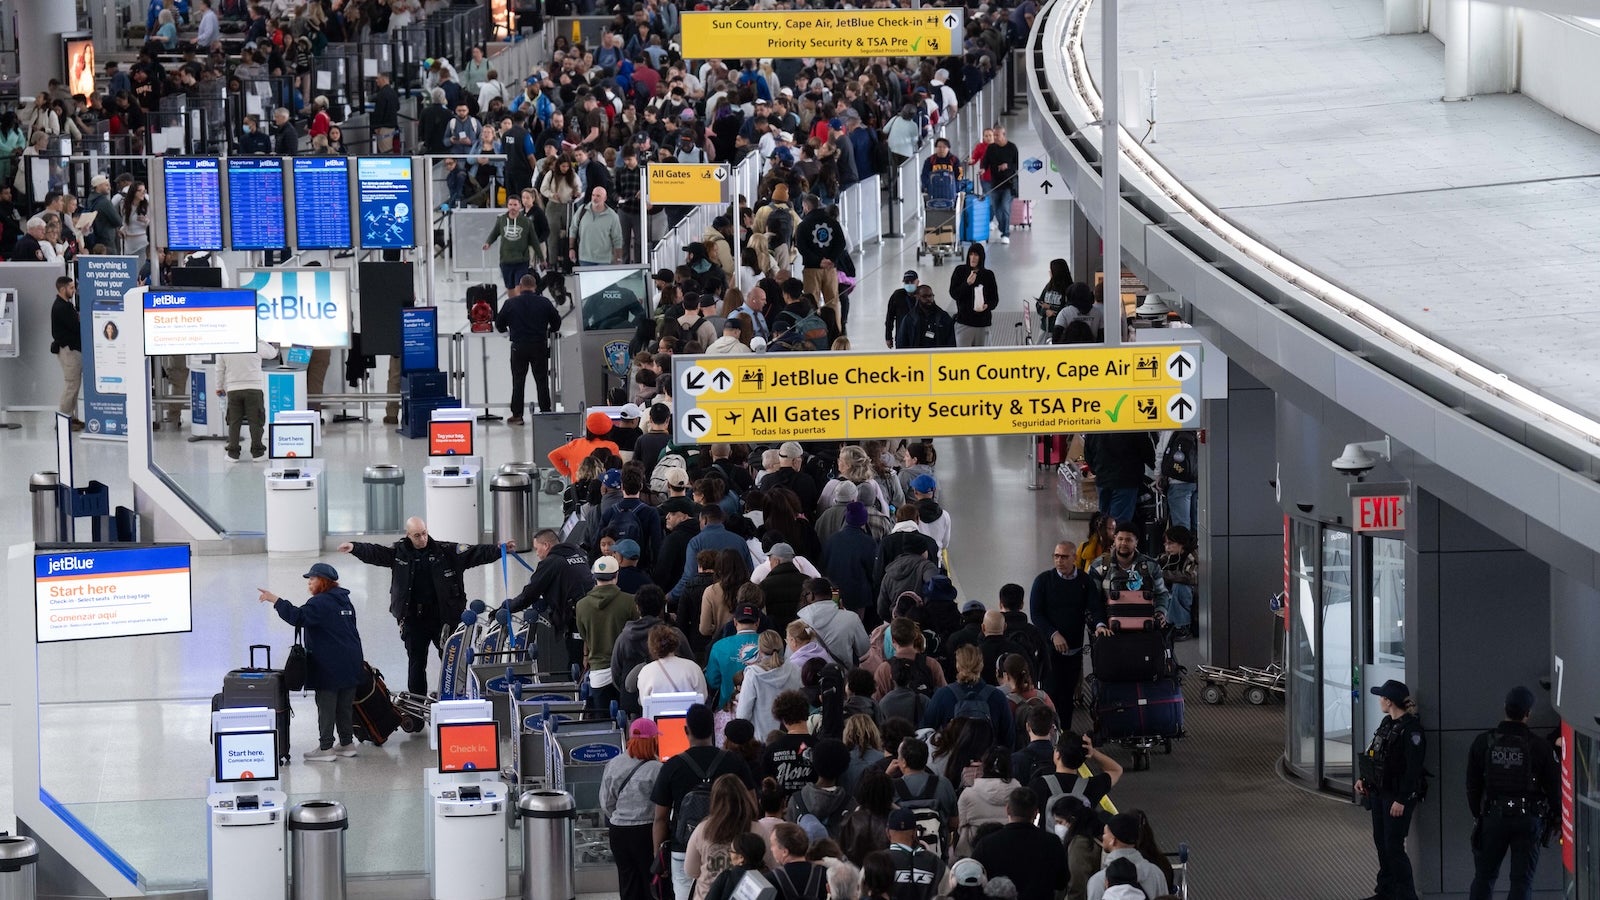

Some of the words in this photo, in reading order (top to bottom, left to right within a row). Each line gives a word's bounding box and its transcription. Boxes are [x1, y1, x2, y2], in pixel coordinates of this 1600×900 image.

[712, 20, 732, 29] Sun
[736, 20, 781, 30] Country,
[786, 19, 812, 30] Cape
[815, 19, 832, 28] Air,
[836, 18, 874, 27] JetBlue
[878, 17, 922, 26] Check-in
[768, 39, 806, 49] Priority
[810, 38, 852, 49] Security
[856, 38, 864, 46] &
[867, 38, 888, 46] TSA
[891, 38, 908, 46] Pre
[196, 160, 215, 168] jetBlue
[652, 170, 664, 178] All
[666, 170, 691, 178] Gates
[89, 262, 122, 270] Everything
[110, 271, 130, 279] phone.
[153, 295, 186, 307] jetBlue
[257, 296, 337, 320] etBlue
[154, 315, 178, 324] Start
[181, 315, 202, 323] here
[607, 344, 629, 354] POLIC
[771, 369, 839, 387] JetBlue
[845, 366, 924, 384] Check-in
[938, 365, 970, 382] Sun
[976, 363, 1050, 383] Country,
[1057, 362, 1099, 380] Cape
[1105, 360, 1130, 376] Air
[751, 406, 777, 424] All
[785, 405, 840, 422] Gates
[853, 402, 921, 422] Priority
[928, 399, 1002, 420] Security
[1010, 400, 1023, 415] &
[1029, 398, 1065, 414] TSA
[1072, 398, 1101, 413] Pre
[1012, 418, 1056, 428] Seguridad
[1058, 417, 1101, 426] Prioritaria
[752, 427, 776, 436] Todas
[778, 427, 791, 435] las
[793, 426, 826, 436] puertas
[1360, 496, 1399, 528] EXIT
[48, 557, 94, 574] jetBlue
[50, 585, 84, 597] Start
[88, 584, 117, 594] here
[50, 613, 95, 622] Comenzar
[98, 611, 117, 621] aquí
[1554, 655, 1564, 707] 7
[450, 745, 476, 753] Check
[1491, 751, 1523, 760] POLICE
